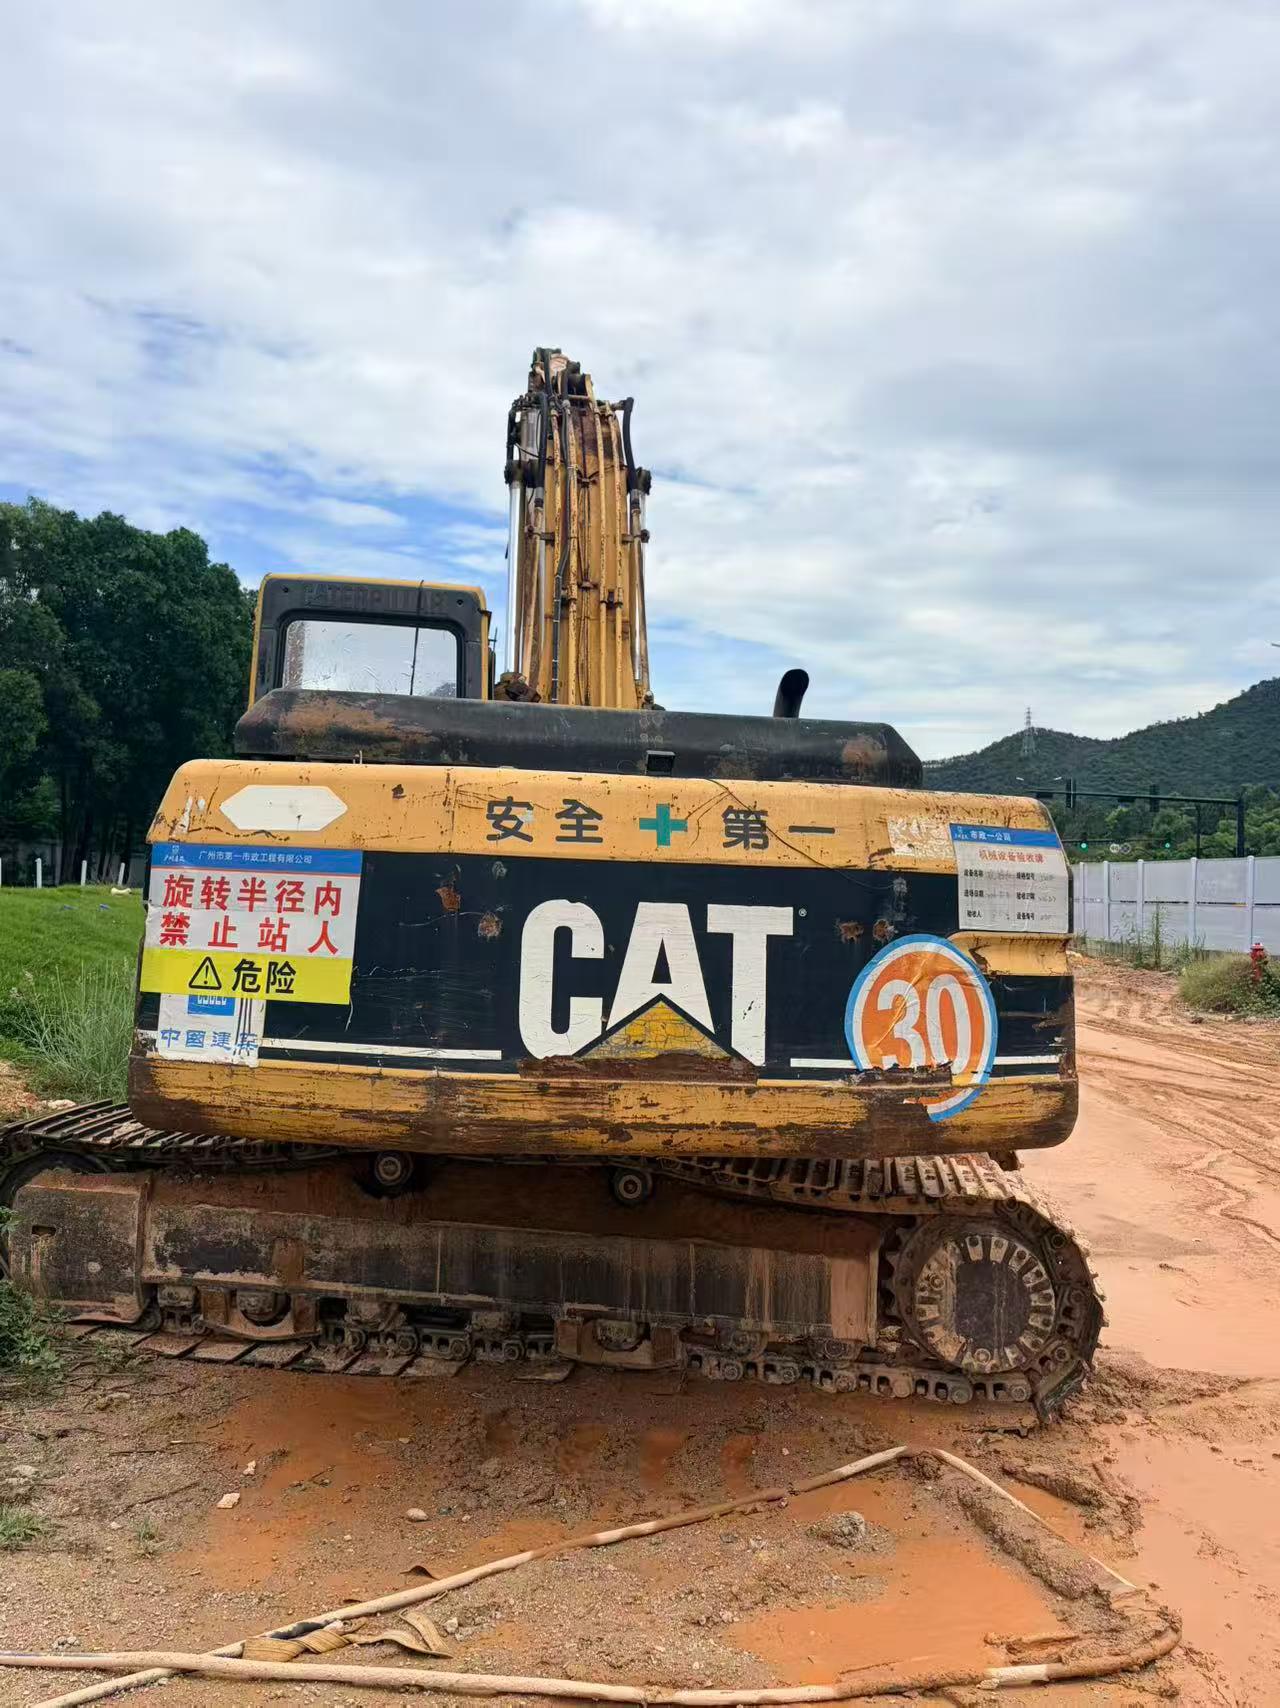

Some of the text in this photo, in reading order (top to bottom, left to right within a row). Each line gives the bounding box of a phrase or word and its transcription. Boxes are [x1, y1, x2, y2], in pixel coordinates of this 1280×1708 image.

[485, 795, 836, 850] 安全 第一
[198, 850, 313, 865] 广州市第一市政工程有限公司
[162, 874, 342, 917] 旋转半径内
[159, 912, 339, 955] 禁止站人
[231, 959, 297, 995] 危险
[518, 899, 794, 1067] CAT
[877, 973, 972, 1075] 30
